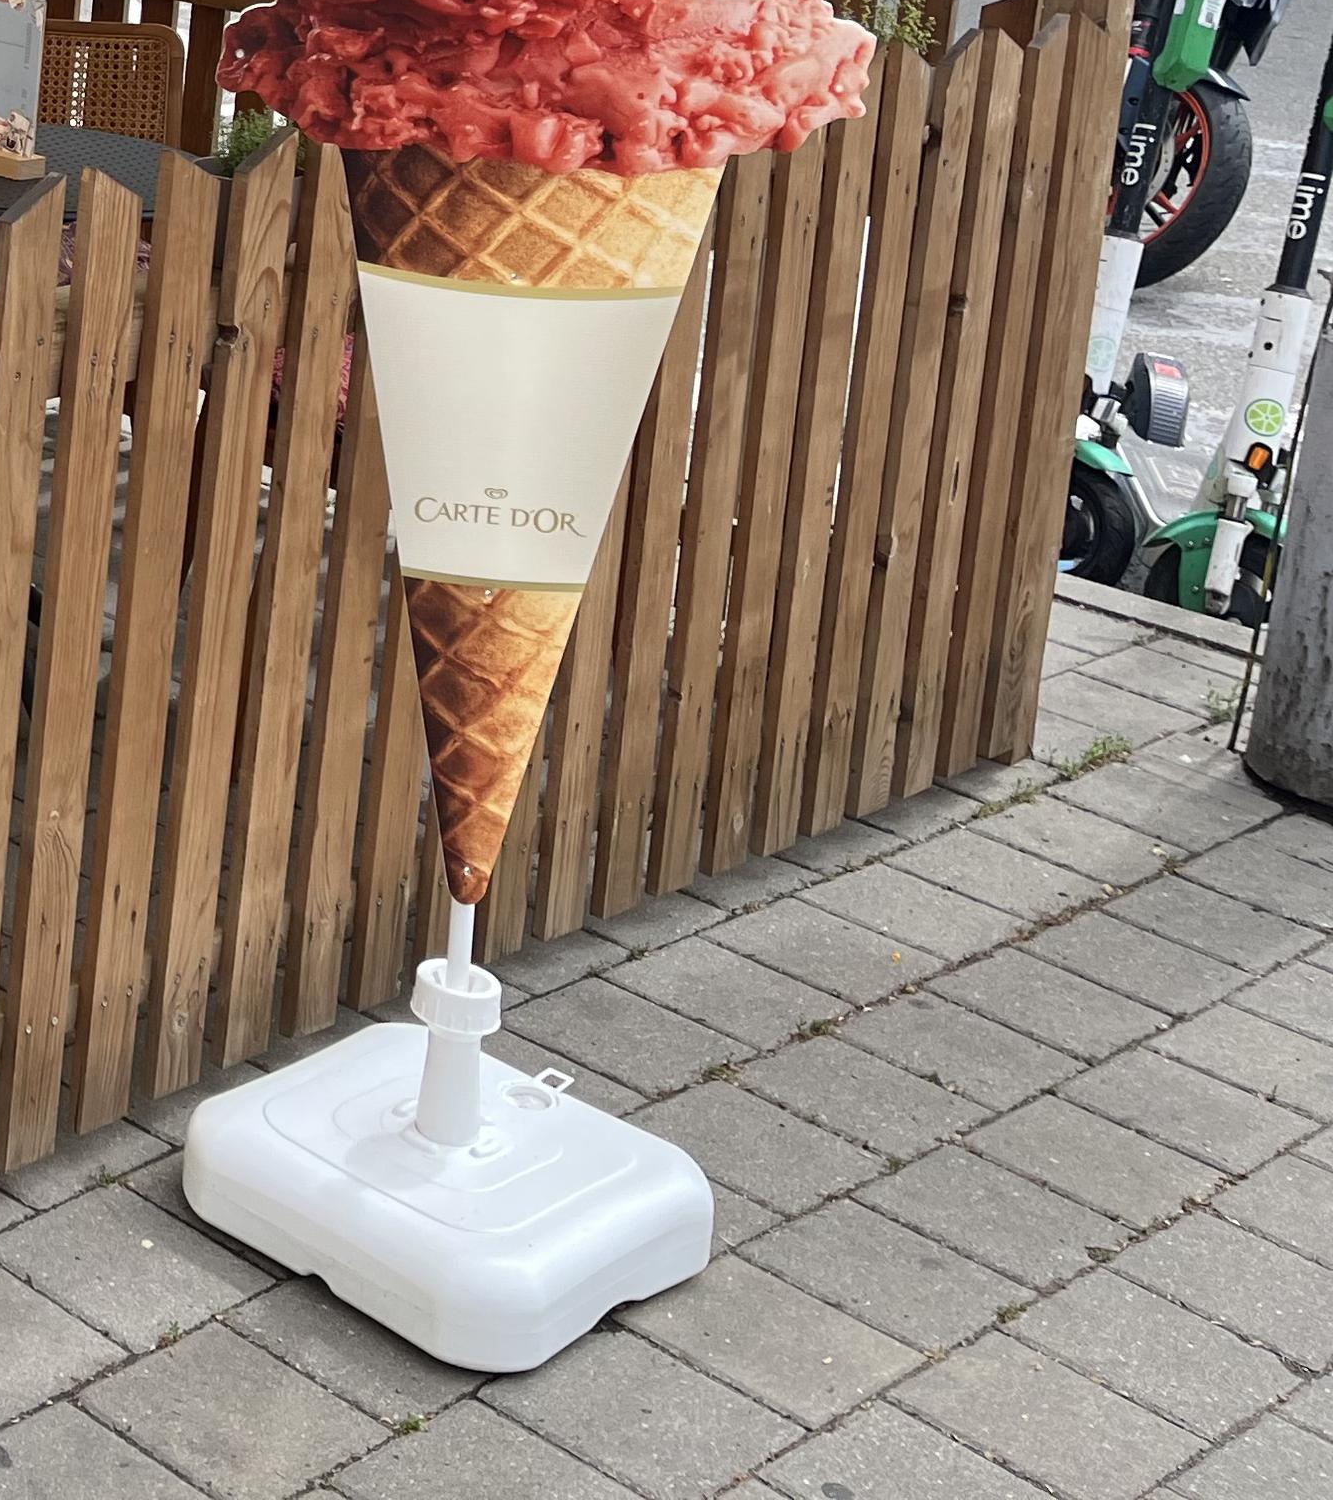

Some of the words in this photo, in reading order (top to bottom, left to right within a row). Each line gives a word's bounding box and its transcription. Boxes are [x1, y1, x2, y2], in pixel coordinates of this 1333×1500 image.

[1121, 123, 1157, 186] Lime
[1286, 172, 1326, 240] Lime
[414, 497, 502, 525] CARTE
[510, 508, 588, 538] D'OR
